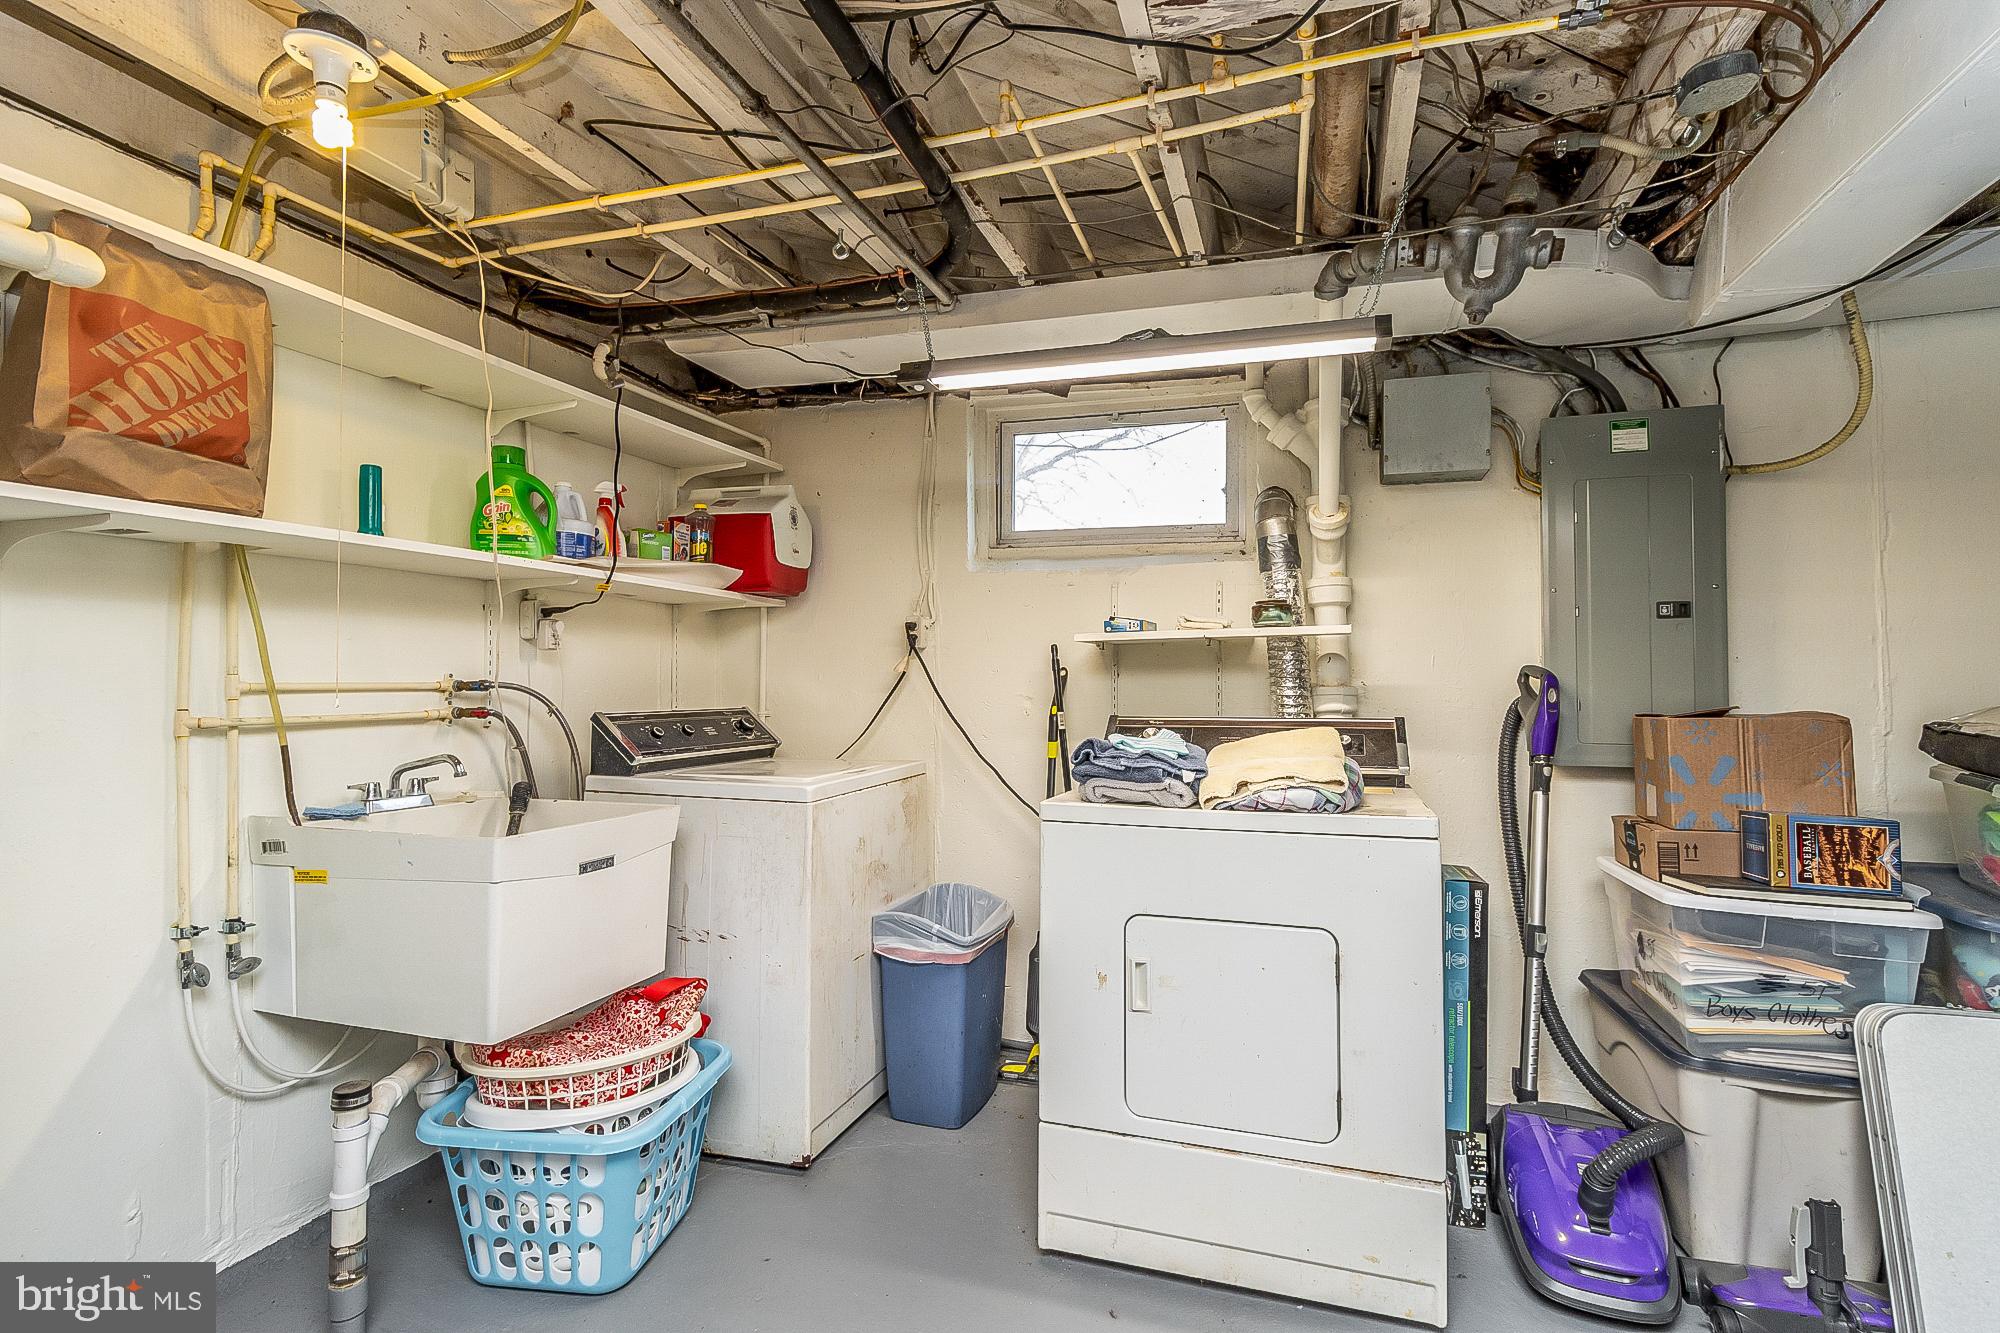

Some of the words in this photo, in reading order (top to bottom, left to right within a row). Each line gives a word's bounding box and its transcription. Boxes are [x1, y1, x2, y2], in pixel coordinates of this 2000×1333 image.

[89, 321, 171, 367] THE
[69, 333, 249, 434] HOME
[148, 385, 248, 447] DEPOT
[483, 502, 511, 516] Gain
[1775, 824, 1783, 842] GOLD
[1776, 843, 1784, 857] DVD
[1802, 827, 1812, 878] BASEBALL
[1474, 898, 1482, 938] Emerson
[1447, 1008, 1456, 1035] refractor
[1706, 995, 1759, 1023] Boys
[1767, 1002, 1854, 1040] Clothes
[1446, 1035, 1456, 1064] telescope
